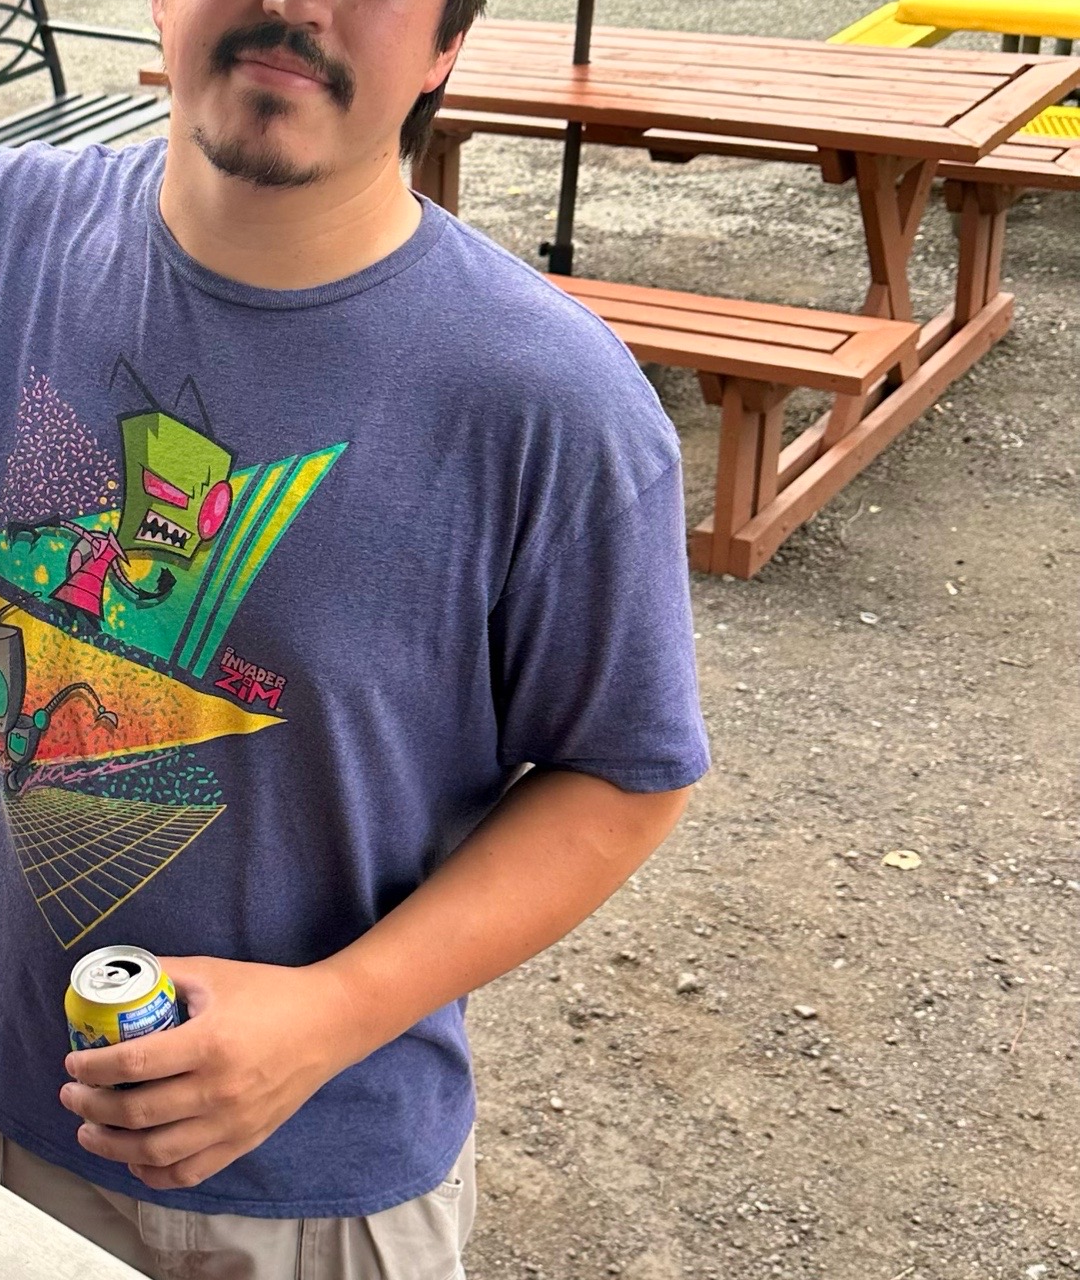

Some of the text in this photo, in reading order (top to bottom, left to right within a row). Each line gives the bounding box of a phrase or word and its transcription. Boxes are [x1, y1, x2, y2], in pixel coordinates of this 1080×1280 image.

[220, 646, 287, 690] INVADER
[123, 1014, 156, 1031] Nutrition
[155, 1000, 172, 1019] Facts
